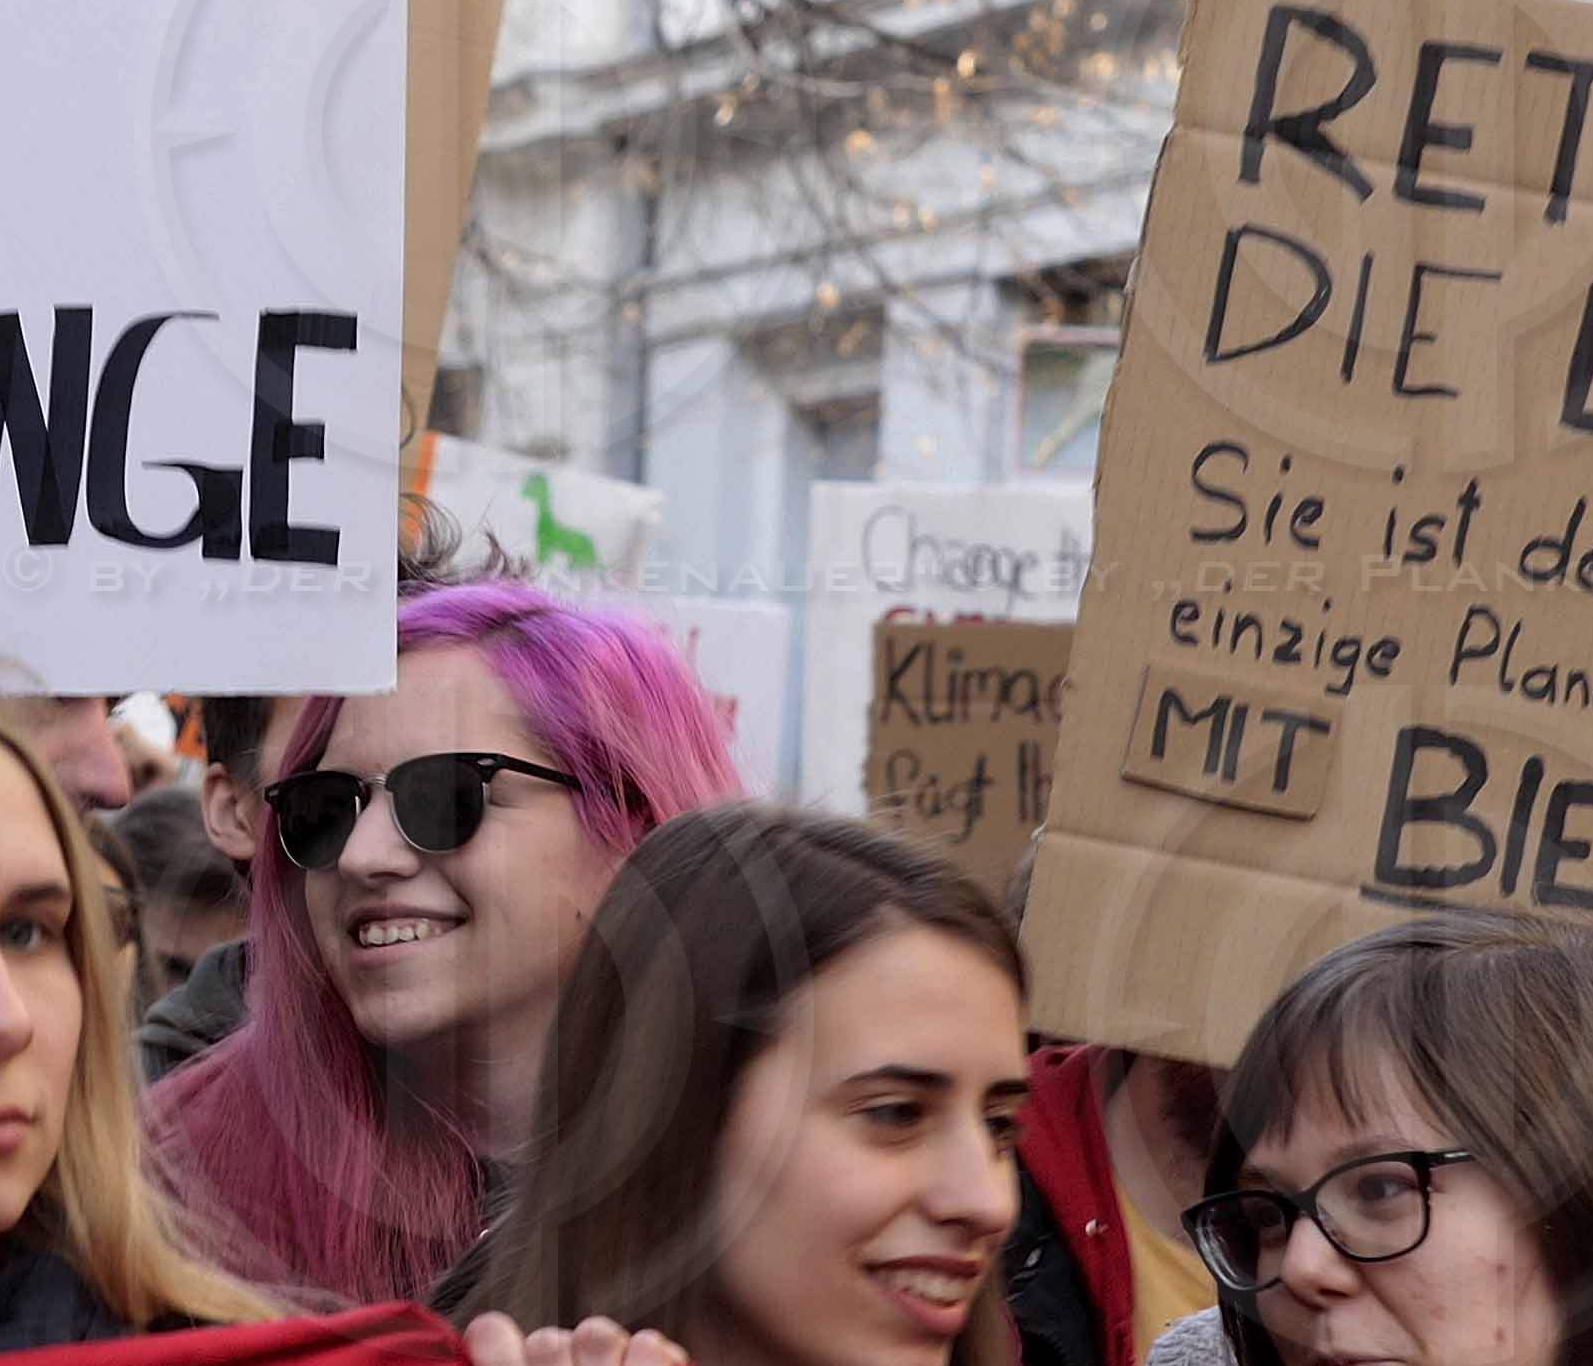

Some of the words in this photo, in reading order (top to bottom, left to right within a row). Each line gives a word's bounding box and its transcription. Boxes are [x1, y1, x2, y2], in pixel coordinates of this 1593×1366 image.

[1202, 224, 1504, 401] DIE
[1186, 441, 1326, 552] Sie
[1381, 467, 1483, 570] ist
[1169, 602, 1402, 698] einzige
[1149, 685, 1331, 798] MIT
